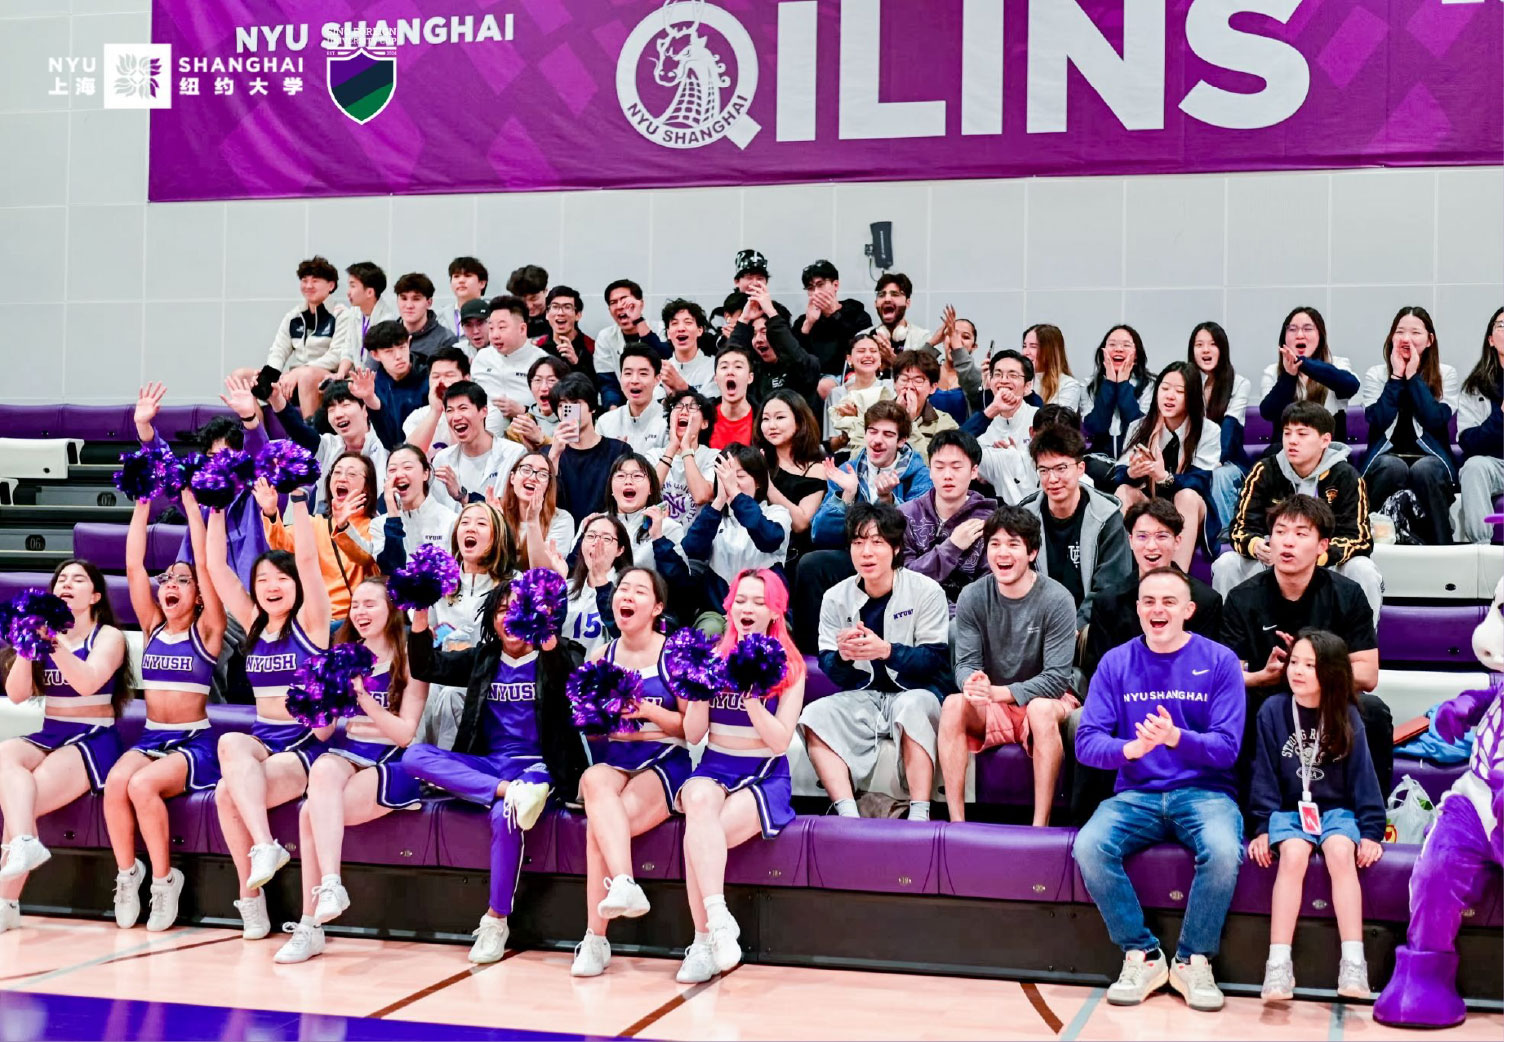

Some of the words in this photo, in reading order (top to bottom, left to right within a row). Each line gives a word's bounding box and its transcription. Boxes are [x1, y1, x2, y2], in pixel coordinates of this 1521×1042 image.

[236, 23, 309, 53] NYU
[320, 13, 514, 50] SHANGHAI
[627, 102, 659, 136] NYU
[662, 94, 748, 145] SHANGHAI
[100, 494, 112, 506] 07
[29, 538, 41, 550] 06
[573, 612, 601, 639] 15
[142, 654, 194, 672] NYUSH
[246, 653, 297, 673] NYUSH
[487, 682, 536, 702] NYUS
[1123, 691, 1148, 702] NYU
[1149, 689, 1209, 702] SHANGHAI
[1281, 729, 1307, 758] STROG
